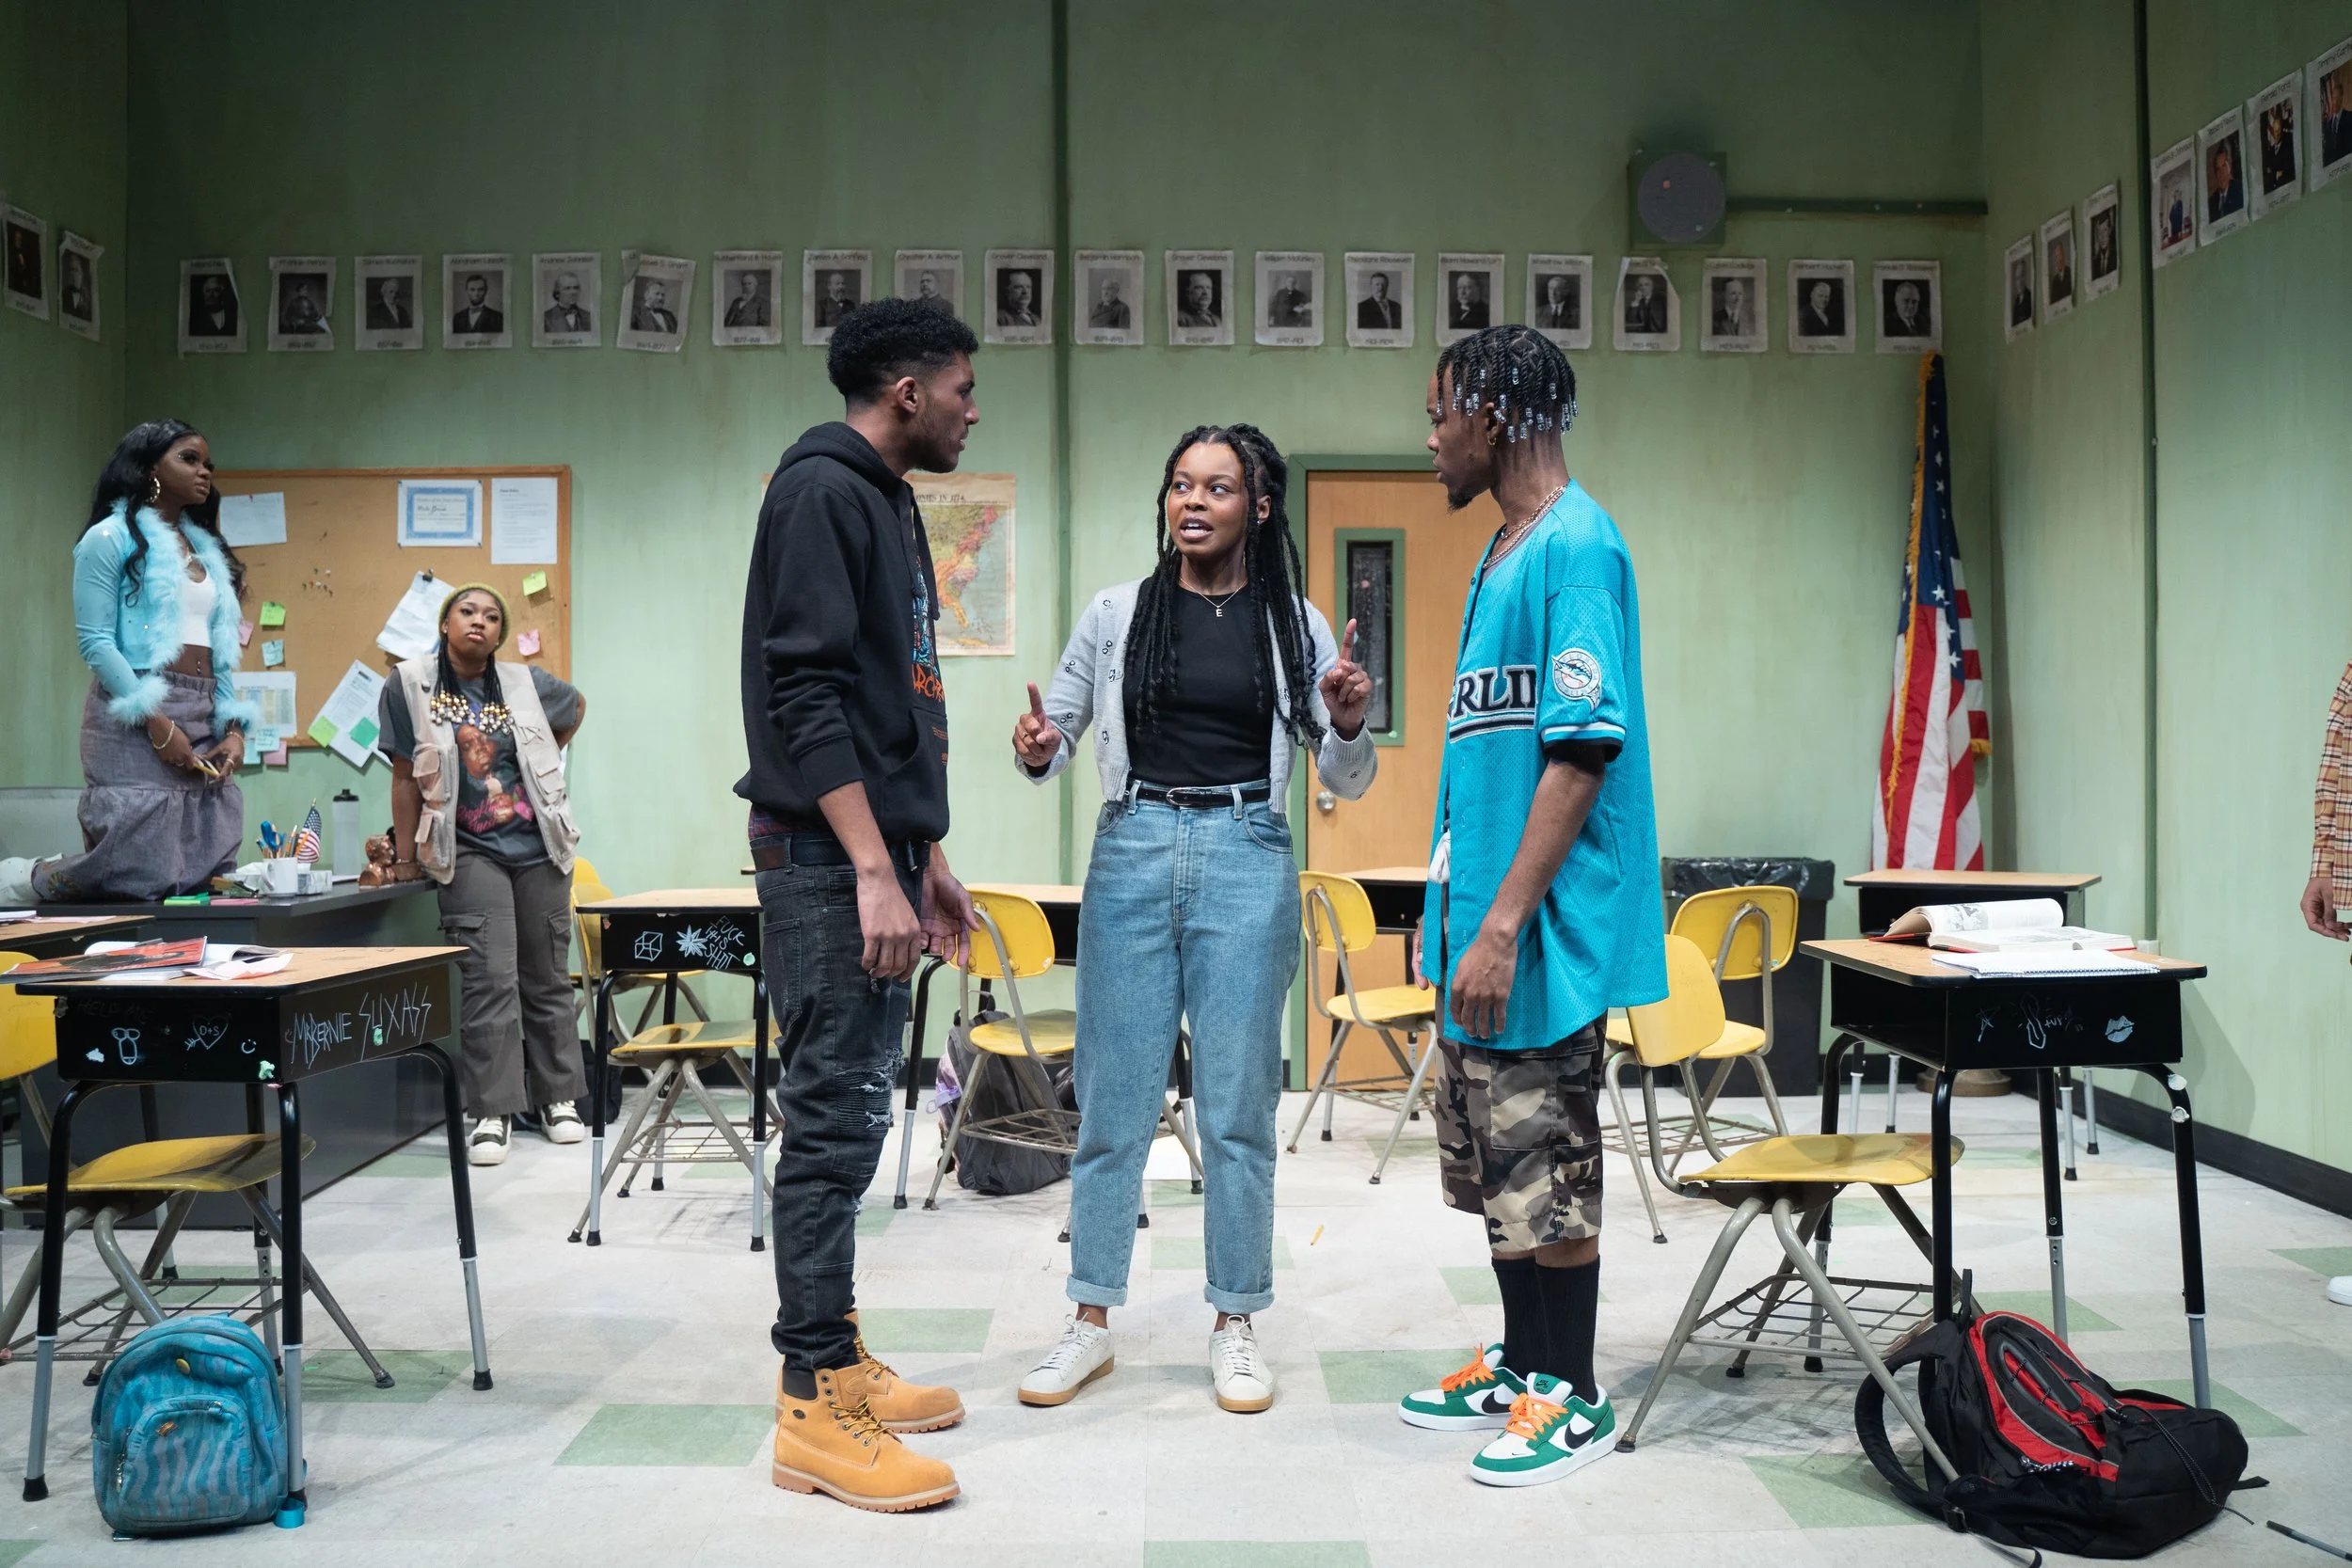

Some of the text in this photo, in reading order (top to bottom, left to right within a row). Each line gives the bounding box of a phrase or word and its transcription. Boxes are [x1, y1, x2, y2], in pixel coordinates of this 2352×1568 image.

[705, 921, 728, 950] THIS
[715, 914, 745, 946] FUCK
[704, 942, 741, 970] SHIT
[199, 1024, 220, 1037] D+S
